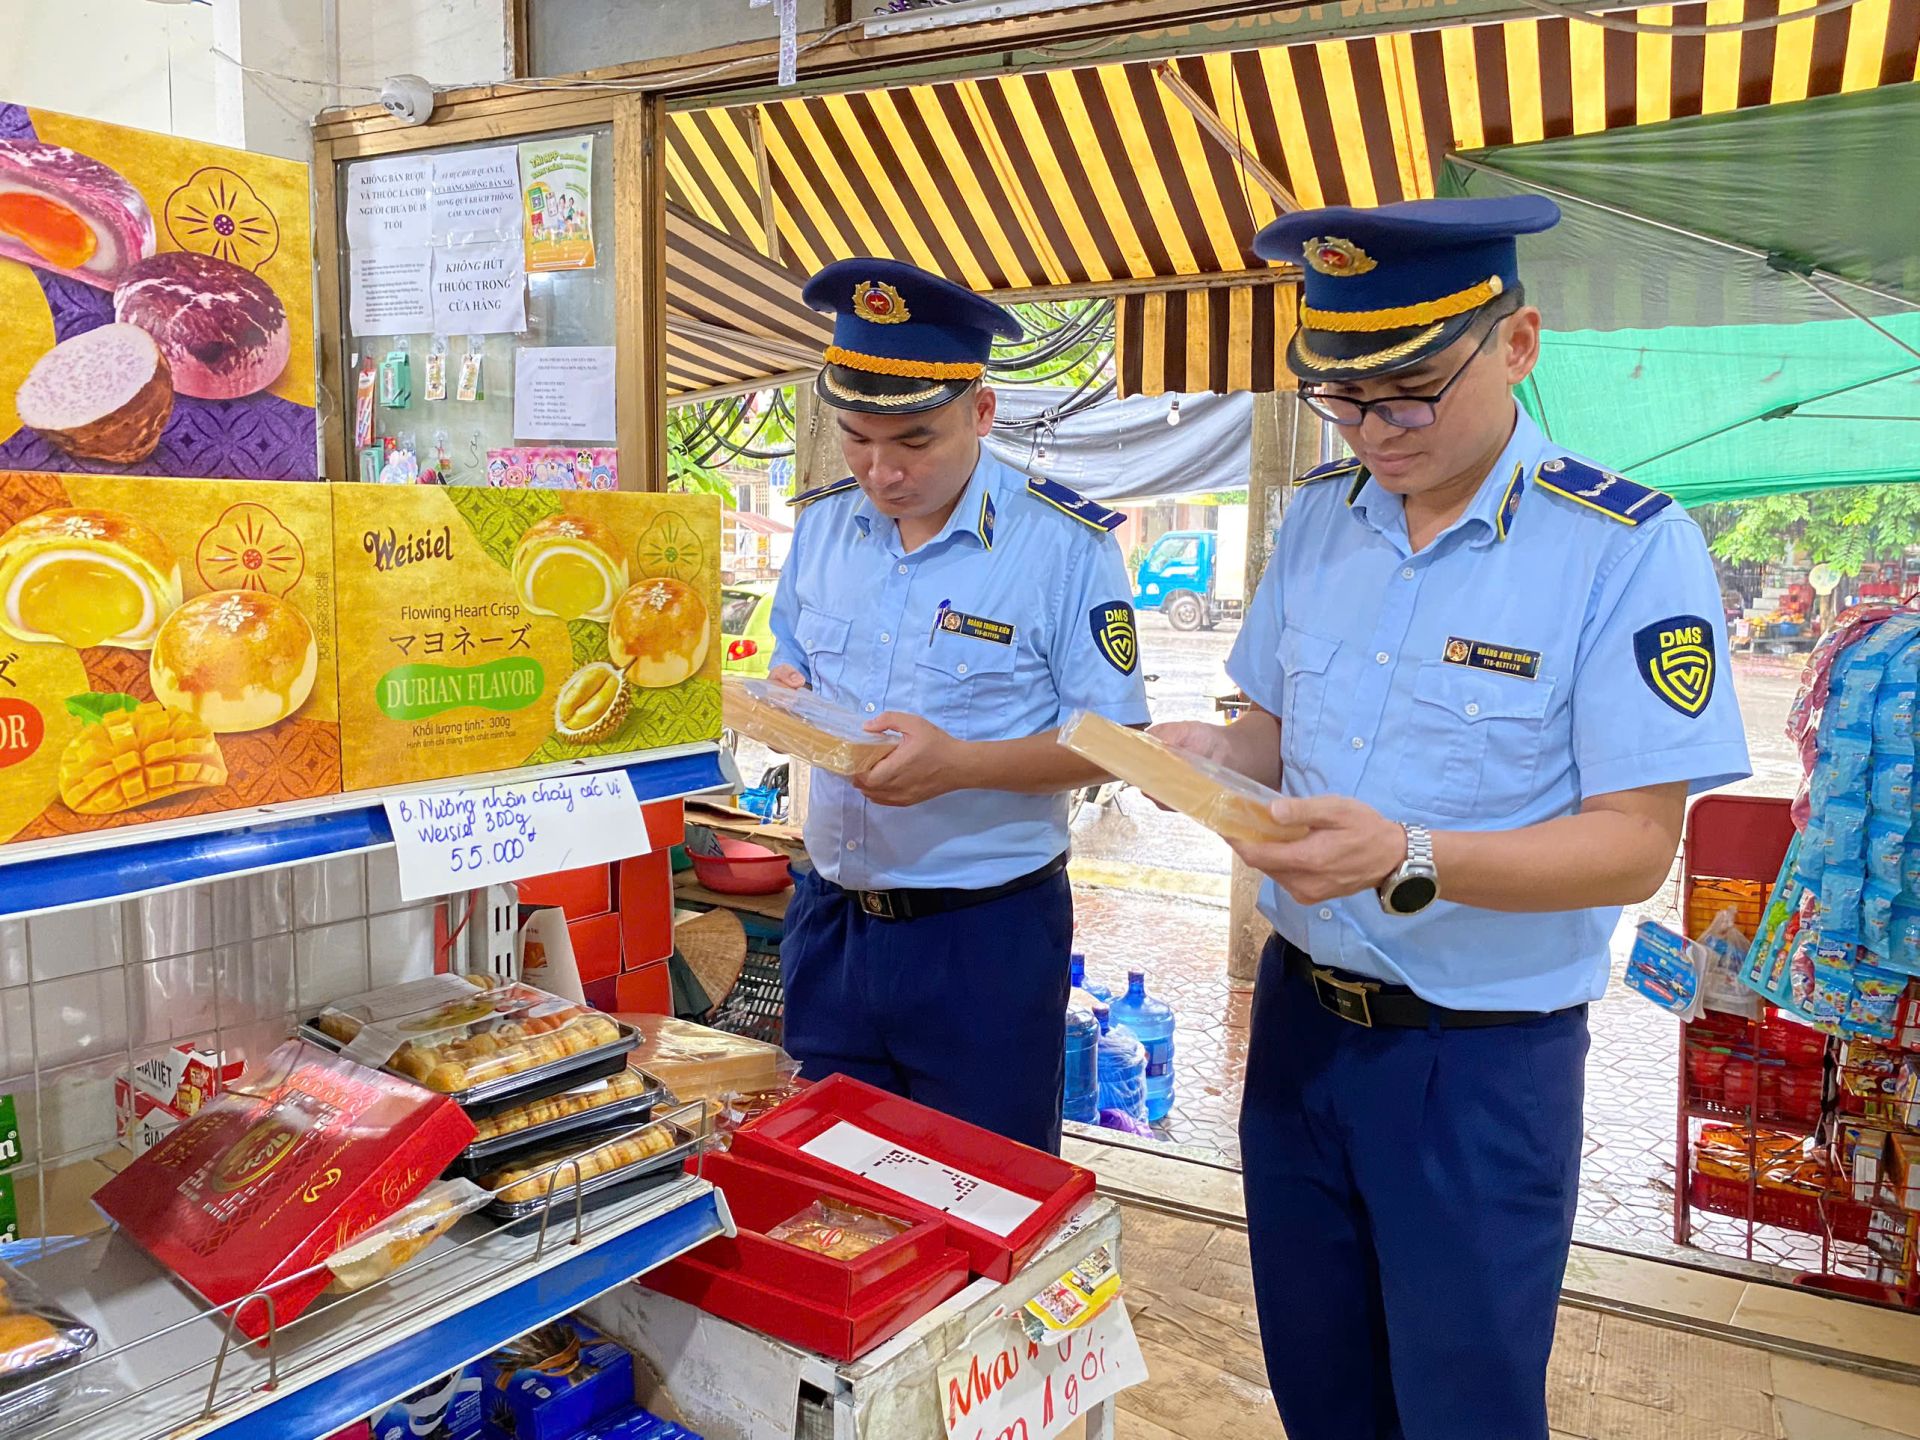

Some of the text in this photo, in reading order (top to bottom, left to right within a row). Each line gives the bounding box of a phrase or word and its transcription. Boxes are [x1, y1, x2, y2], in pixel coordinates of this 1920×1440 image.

[361, 173, 387, 184] KHÔNG
[446, 257, 504, 273] KHÔNG HÚT
[437, 278, 511, 293] THUỐC TRONG
[448, 297, 501, 311] CỬA HÀNG
[363, 525, 454, 572] Weisiel
[401, 602, 520, 622] Flowing Heart Crisp
[1104, 610, 1129, 623] DMS
[388, 622, 532, 656] マヨネーズ
[1659, 626, 1702, 648] DMS
[386, 669, 536, 709] DURIAN FLAVOR
[412, 716, 511, 737] Khối lượng tịnh: 300g
[485, 809, 532, 835] 300g
[374, 1166, 423, 1208] Cake
